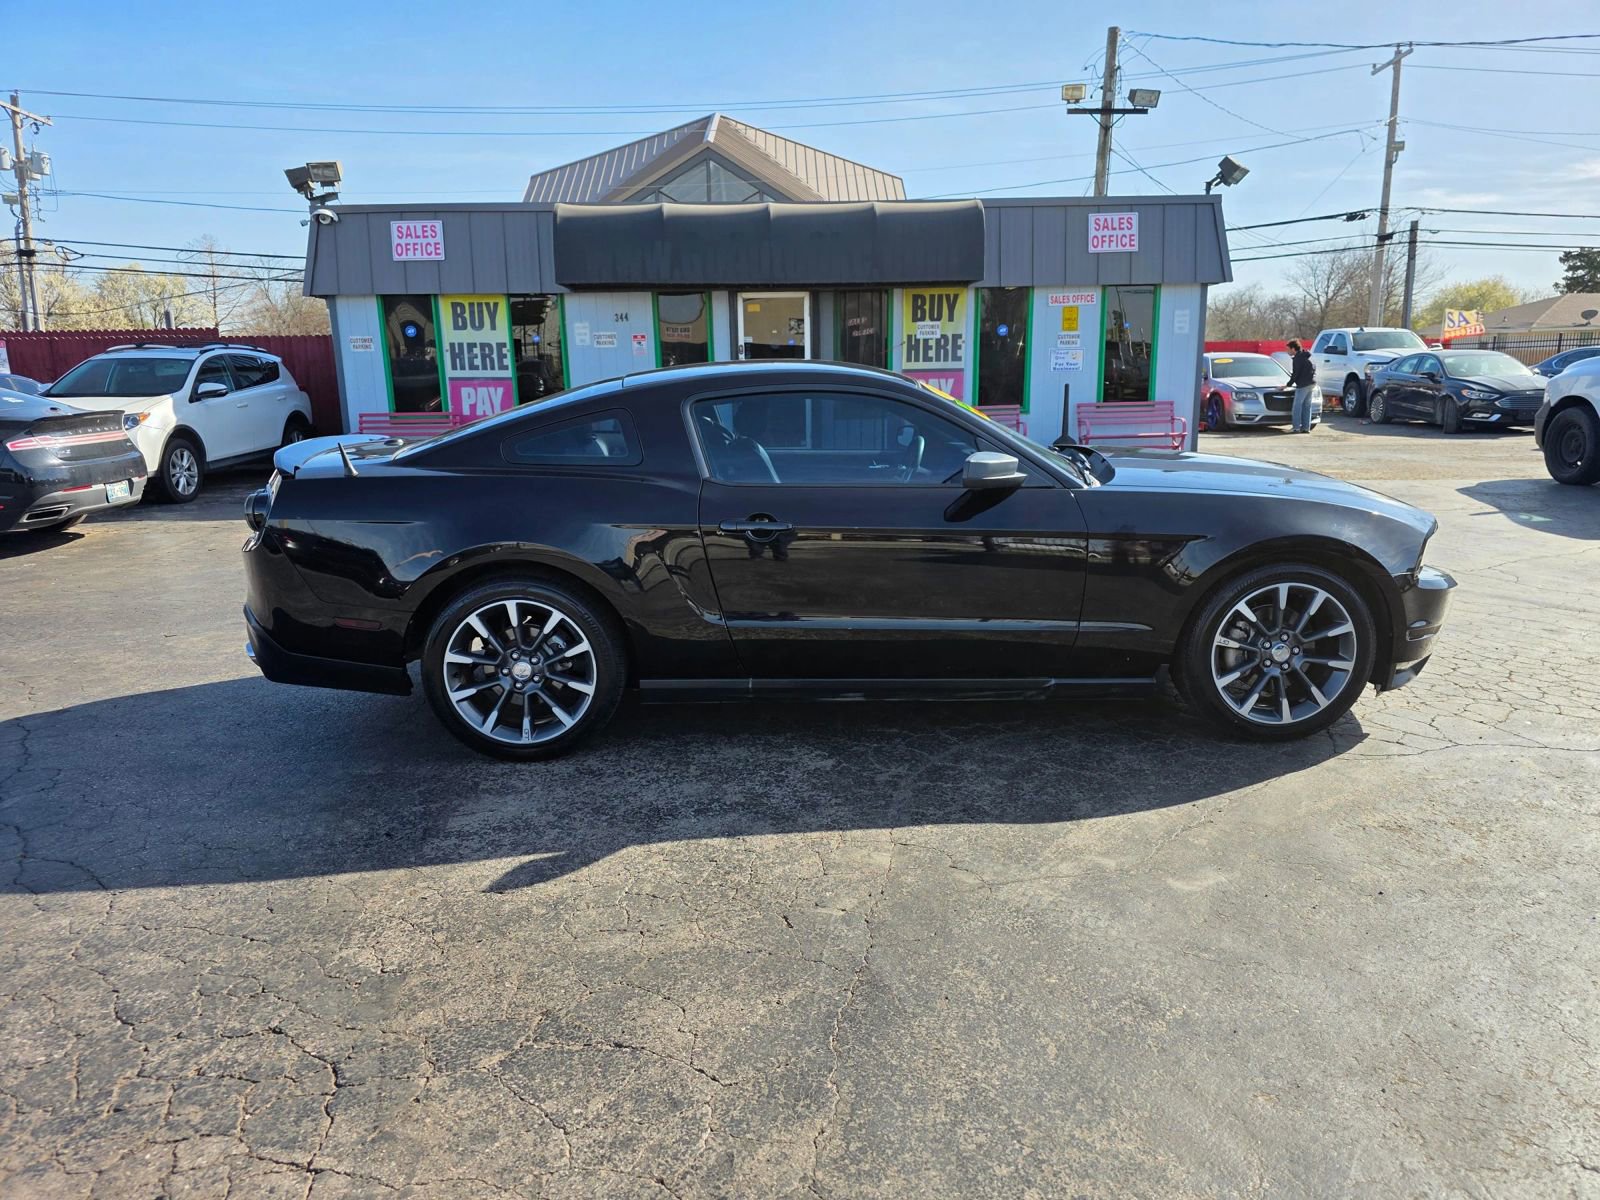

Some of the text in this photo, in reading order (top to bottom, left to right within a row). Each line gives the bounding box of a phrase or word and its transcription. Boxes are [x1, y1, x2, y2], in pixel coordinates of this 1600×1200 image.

[396, 224, 438, 240] SALES
[1094, 216, 1133, 232] SALES
[1091, 233, 1136, 249] OFFICE
[395, 242, 442, 257] OFFICE
[1050, 294, 1095, 304] SALES OFFICE
[911, 293, 960, 323] BUY
[450, 301, 499, 332] BUY
[614, 313, 629, 322] 344
[906, 333, 963, 363] HERE
[448, 342, 510, 371] HERE
[460, 387, 504, 416] PAY
